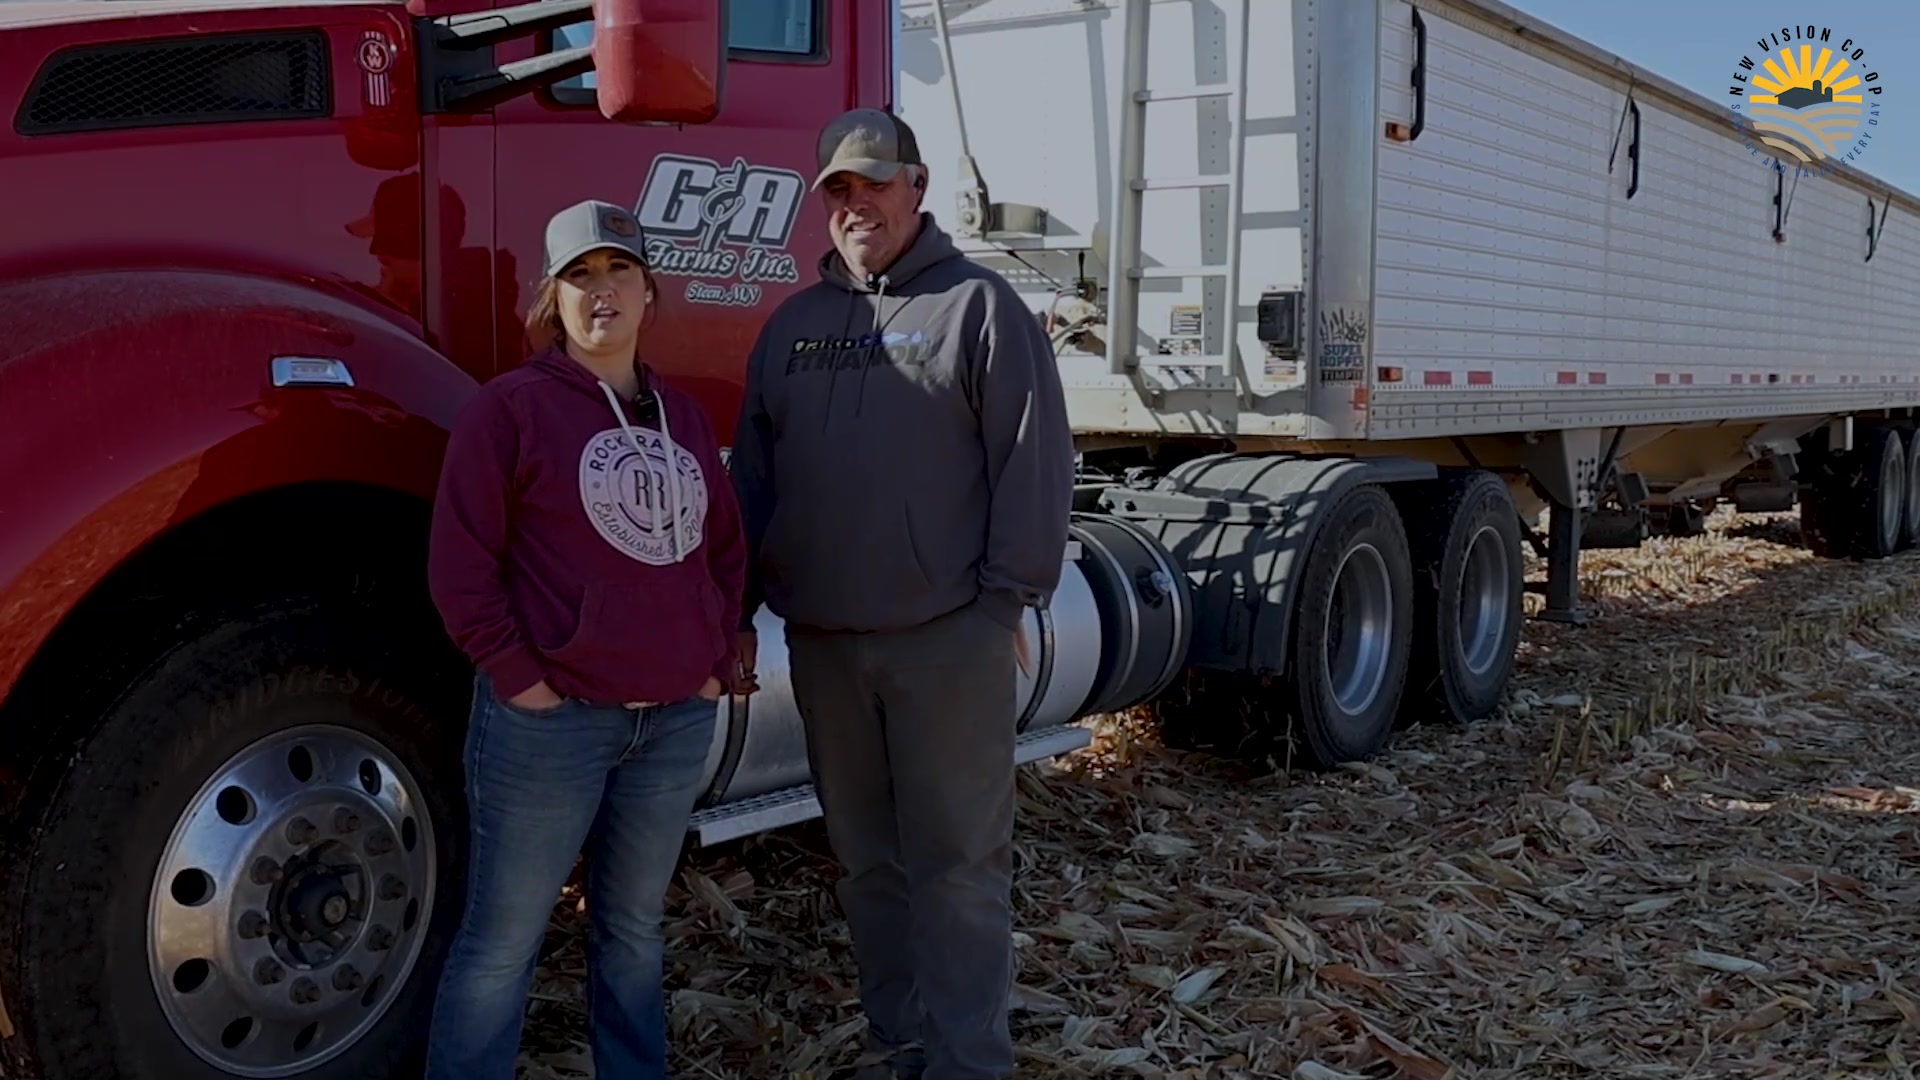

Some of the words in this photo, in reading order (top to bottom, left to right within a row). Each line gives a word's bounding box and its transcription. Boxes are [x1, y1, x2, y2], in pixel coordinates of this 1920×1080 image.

[635, 153, 805, 250] G&A
[648, 240, 737, 276] Farms
[741, 248, 798, 281] Inc.
[589, 435, 629, 472] ROCK
[636, 435, 700, 482] RACH
